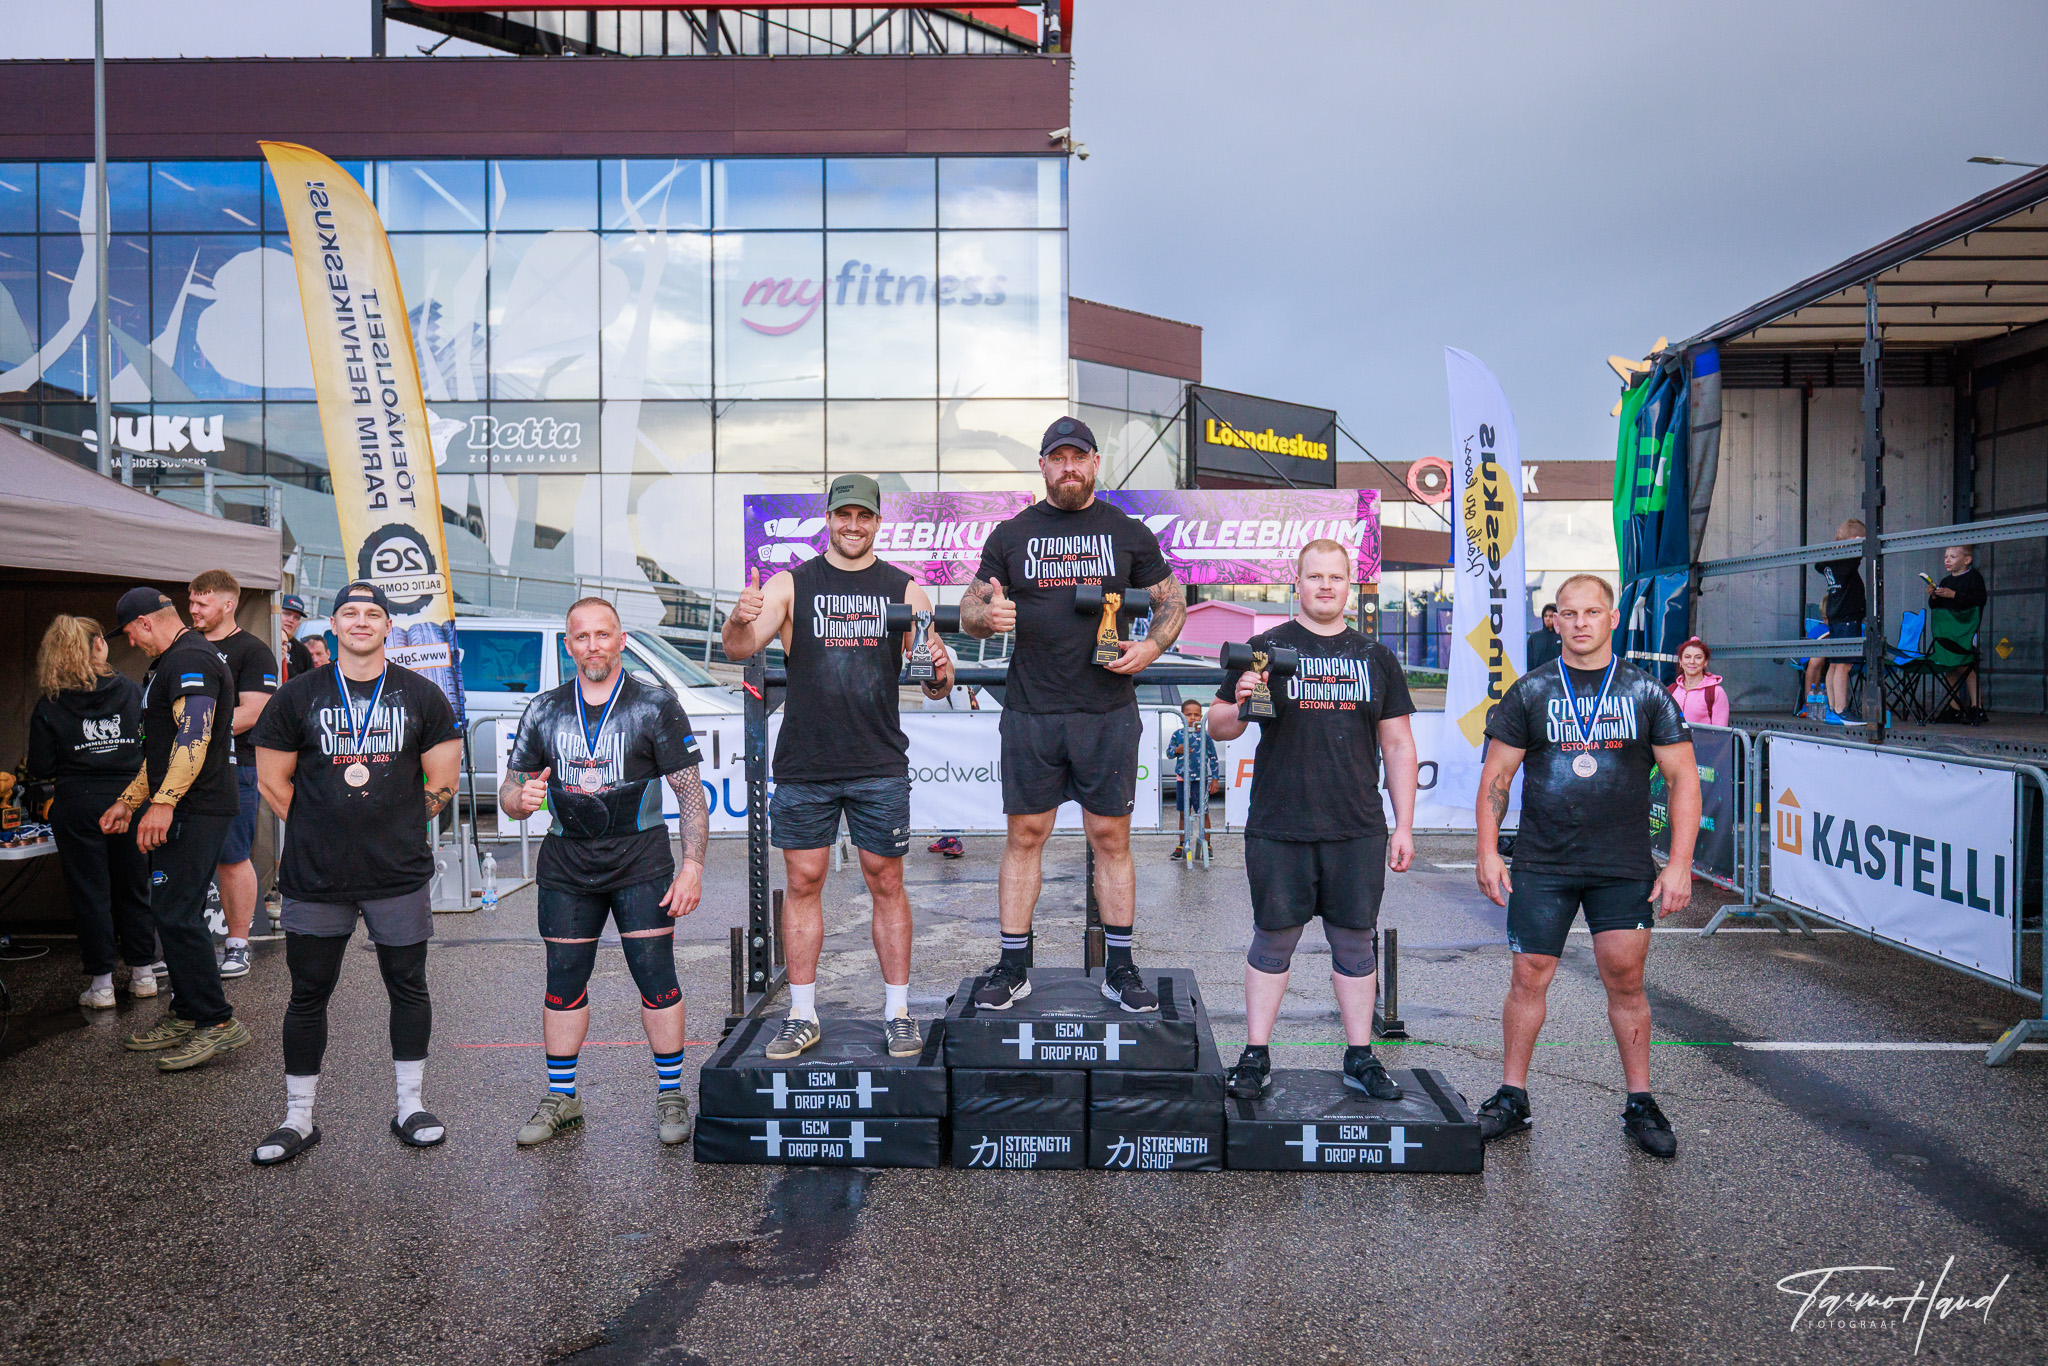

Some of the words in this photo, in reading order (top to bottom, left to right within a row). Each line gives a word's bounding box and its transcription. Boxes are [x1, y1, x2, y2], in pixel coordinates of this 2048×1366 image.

[467, 416, 581, 449] Betta
[1206, 418, 1328, 461] Lõunakeskus
[469, 454, 578, 463] ZOOKAUPLUS
[872, 521, 1001, 549] EEBIKU
[1171, 520, 1368, 547] KLEEBIKUM
[1025, 534, 1115, 561] STRONGMAN
[931, 551, 983, 560] REKLA
[1062, 554, 1078, 562] PRO
[1025, 555, 1116, 579] STRONGWOMAN
[1038, 578, 1078, 588] ESTONIA
[1083, 577, 1102, 586] 2026
[846, 612, 860, 621] PRO
[825, 638, 859, 647] ESTONIA
[862, 638, 878, 647] 2026
[1322, 675, 1336, 684] PRO
[1299, 700, 1335, 710] ESTONIA
[1339, 702, 1356, 710] 2026
[1605, 740, 1623, 749] 2026
[372, 754, 390, 763] 2026
[907, 761, 1002, 783] oodwell
[1812, 811, 2005, 917] KASTELLI
[1055, 1023, 1084, 1037] 15CM
[1041, 1046, 1071, 1060] DROP
[1075, 1046, 1098, 1061] PAD
[808, 1072, 836, 1086] 15CM
[794, 1095, 825, 1109] DROP
[828, 1094, 851, 1109] PAD
[801, 1121, 829, 1135] 15CM
[1339, 1125, 1368, 1140] 15CM
[788, 1143, 818, 1157] DROP
[821, 1143, 844, 1158] PAD
[1005, 1136, 1071, 1152] STRENGTH
[1142, 1136, 1208, 1153] STRENGTH
[1005, 1152, 1037, 1168] SHOP
[1141, 1153, 1173, 1169] SHOP
[1324, 1148, 1356, 1163] DROP
[1359, 1148, 1383, 1163] PAD
